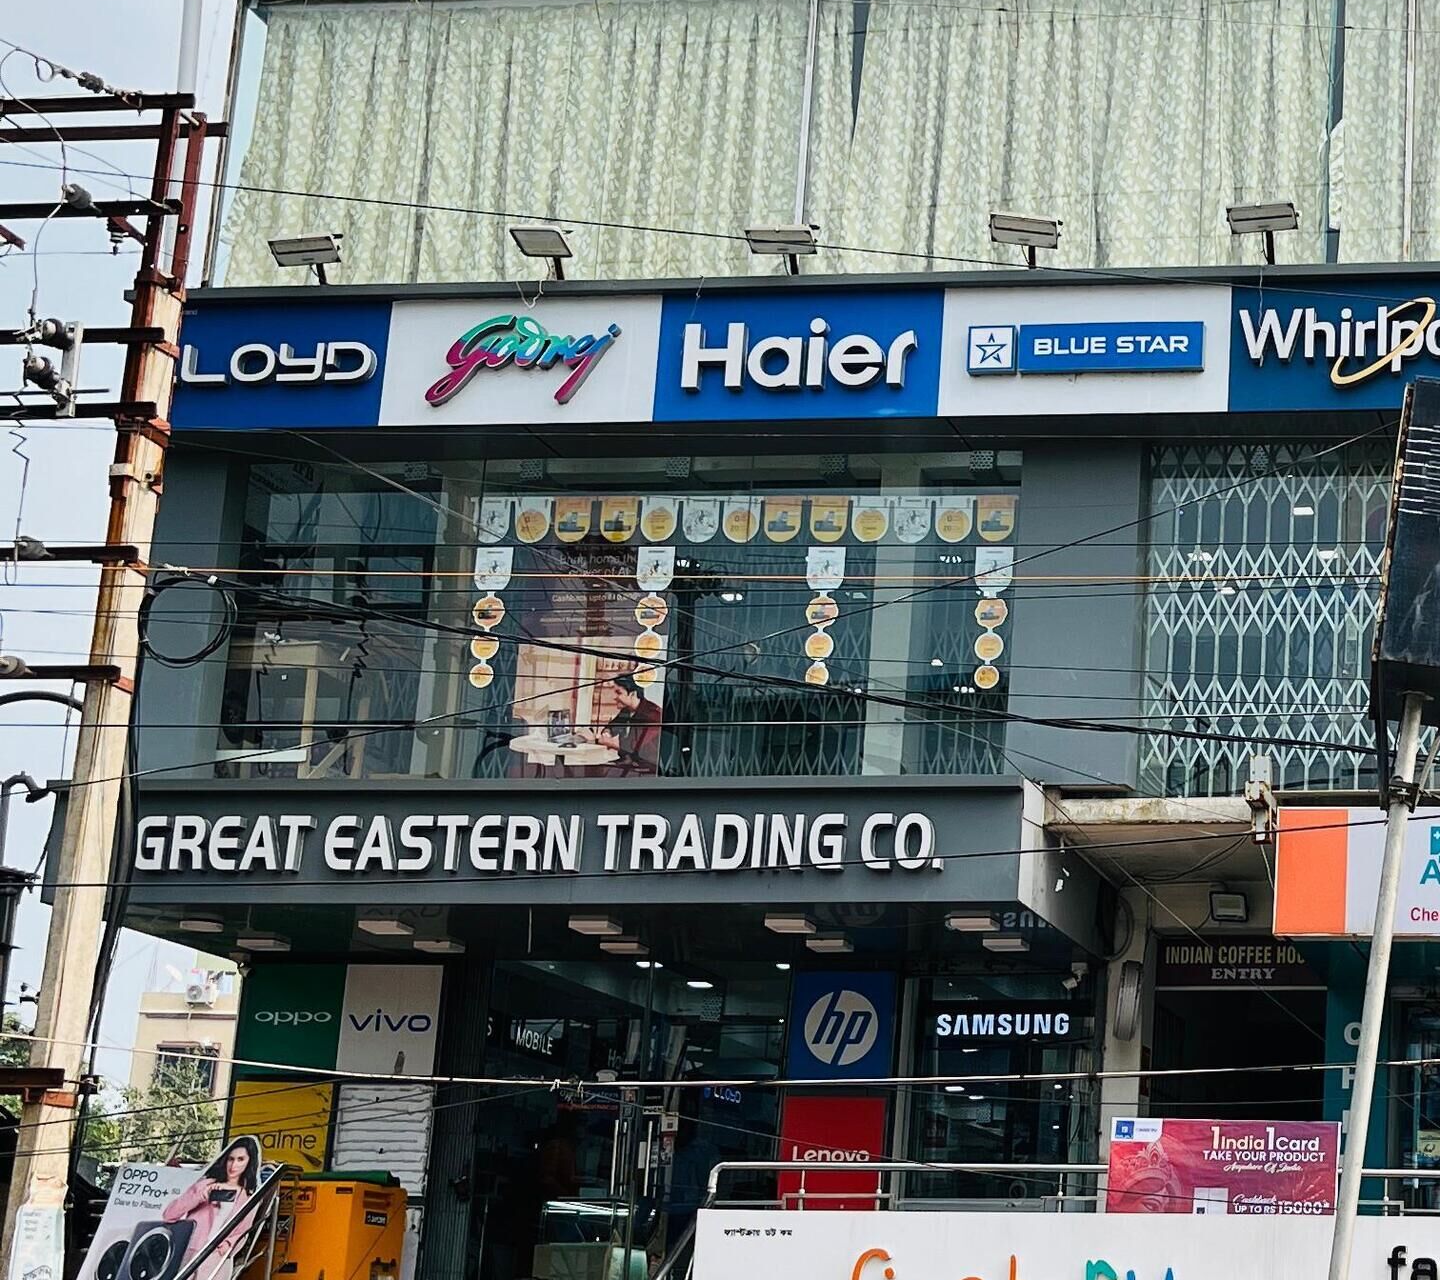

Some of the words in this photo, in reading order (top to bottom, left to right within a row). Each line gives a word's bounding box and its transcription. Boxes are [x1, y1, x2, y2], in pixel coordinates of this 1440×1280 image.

[681, 317, 918, 391] Haier
[1033, 335, 1110, 357] BLUE
[1115, 332, 1190, 355] STAR
[180, 340, 378, 384] LOYD
[425, 313, 622, 407] Godrej
[134, 815, 315, 871] GREAT
[323, 814, 582, 872] EASTERN
[596, 812, 848, 871] TRADING
[860, 812, 945, 872] CO.
[1165, 946, 1213, 965] INDIAN
[1218, 946, 1272, 965] COFFEE
[1211, 968, 1276, 980] ENTRY
[349, 1008, 432, 1032] vivo
[811, 990, 874, 1066] hp
[936, 1012, 1070, 1037] SAMSUNG
[515, 1026, 553, 1055] MOBILE
[262, 1130, 317, 1150] alme
[792, 1145, 870, 1162] Lenovo
[1203, 1151, 1232, 1161] TAKE
[1236, 1151, 1267, 1162] YOUR
[1269, 1151, 1325, 1162] PRODUCT
[122, 1168, 158, 1183] OPPO
[118, 1182, 142, 1196] F27
[142, 1184, 169, 1198] Pro+
[1234, 1204, 1247, 1214] UP
[1249, 1204, 1262, 1214] TO
[1263, 1204, 1276, 1214] RS
